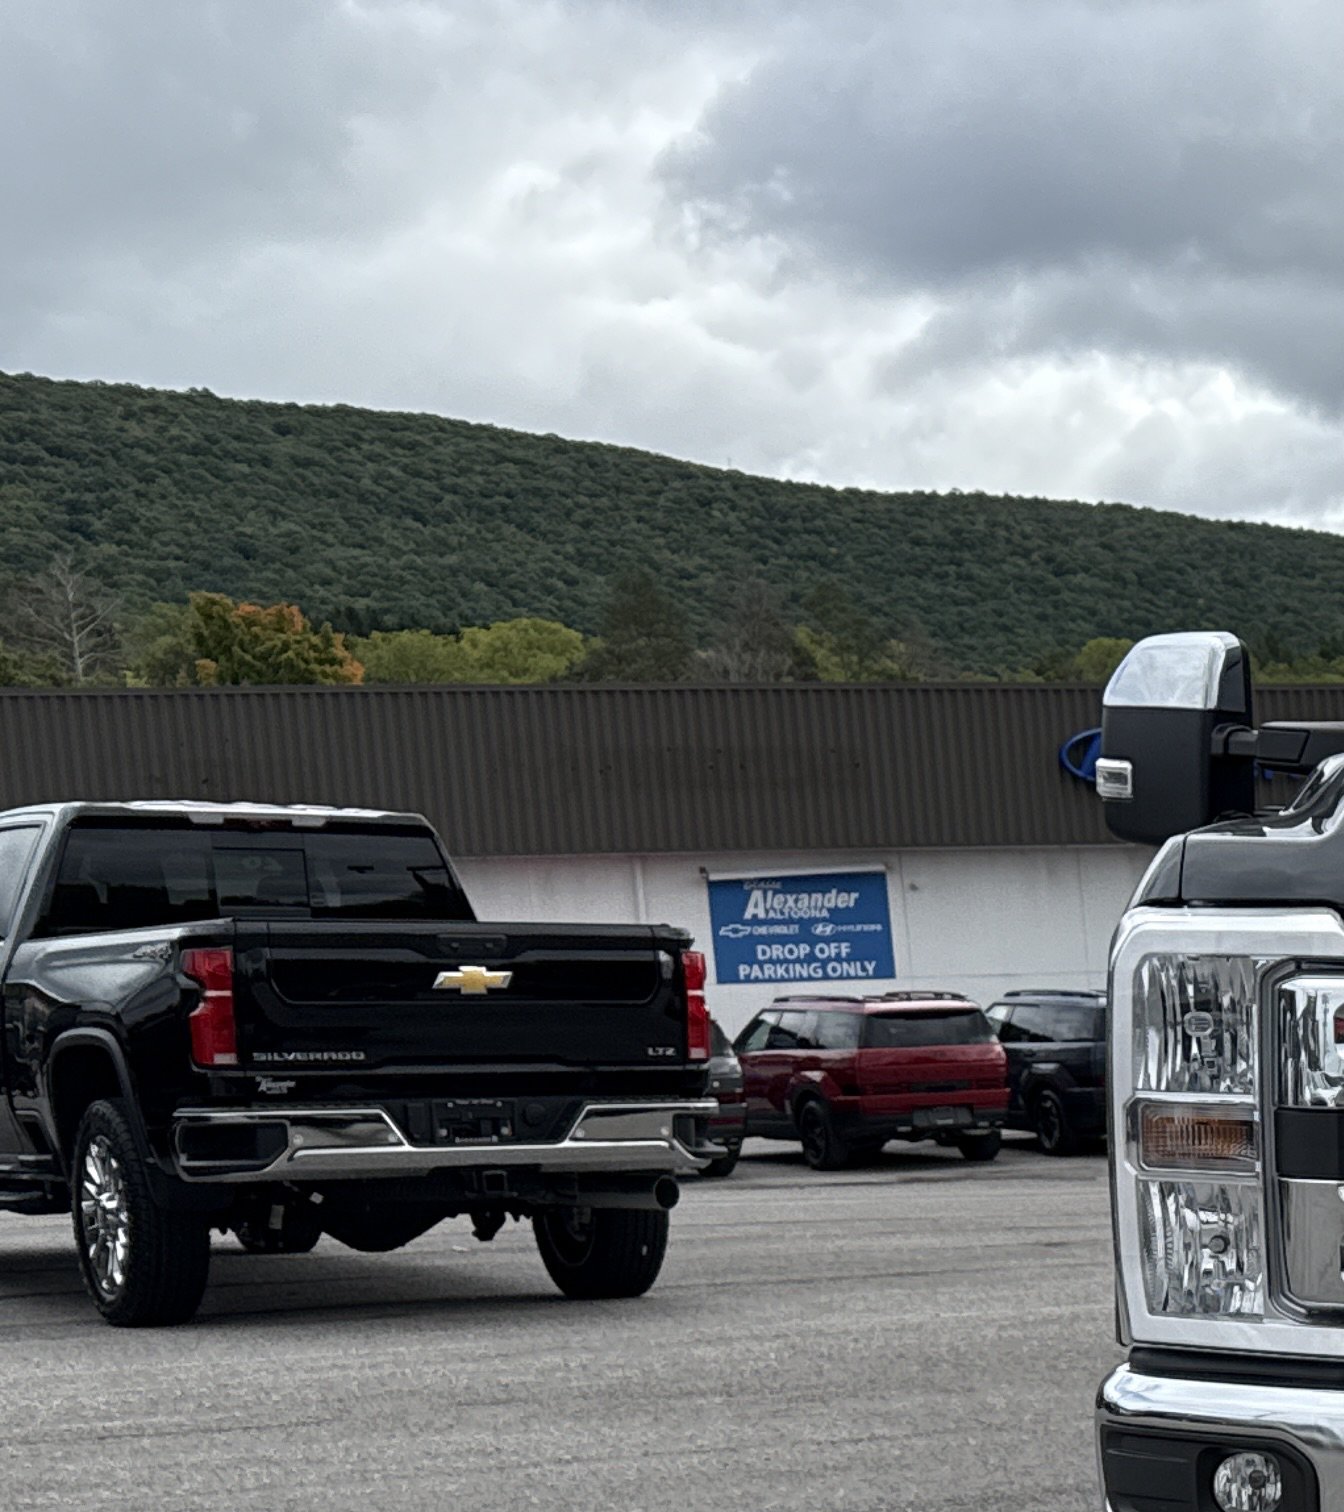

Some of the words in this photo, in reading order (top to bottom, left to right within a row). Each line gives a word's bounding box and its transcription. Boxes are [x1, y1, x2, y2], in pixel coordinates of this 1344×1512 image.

[743, 888, 859, 919] Alexander
[767, 906, 830, 919] ALTOONA
[756, 943, 811, 961] DROP
[814, 942, 852, 959] OFF
[738, 962, 823, 980] PARKING
[826, 960, 877, 977] ONLY
[252, 1051, 366, 1061] SILVERADO
[647, 1046, 677, 1056] LTZ
